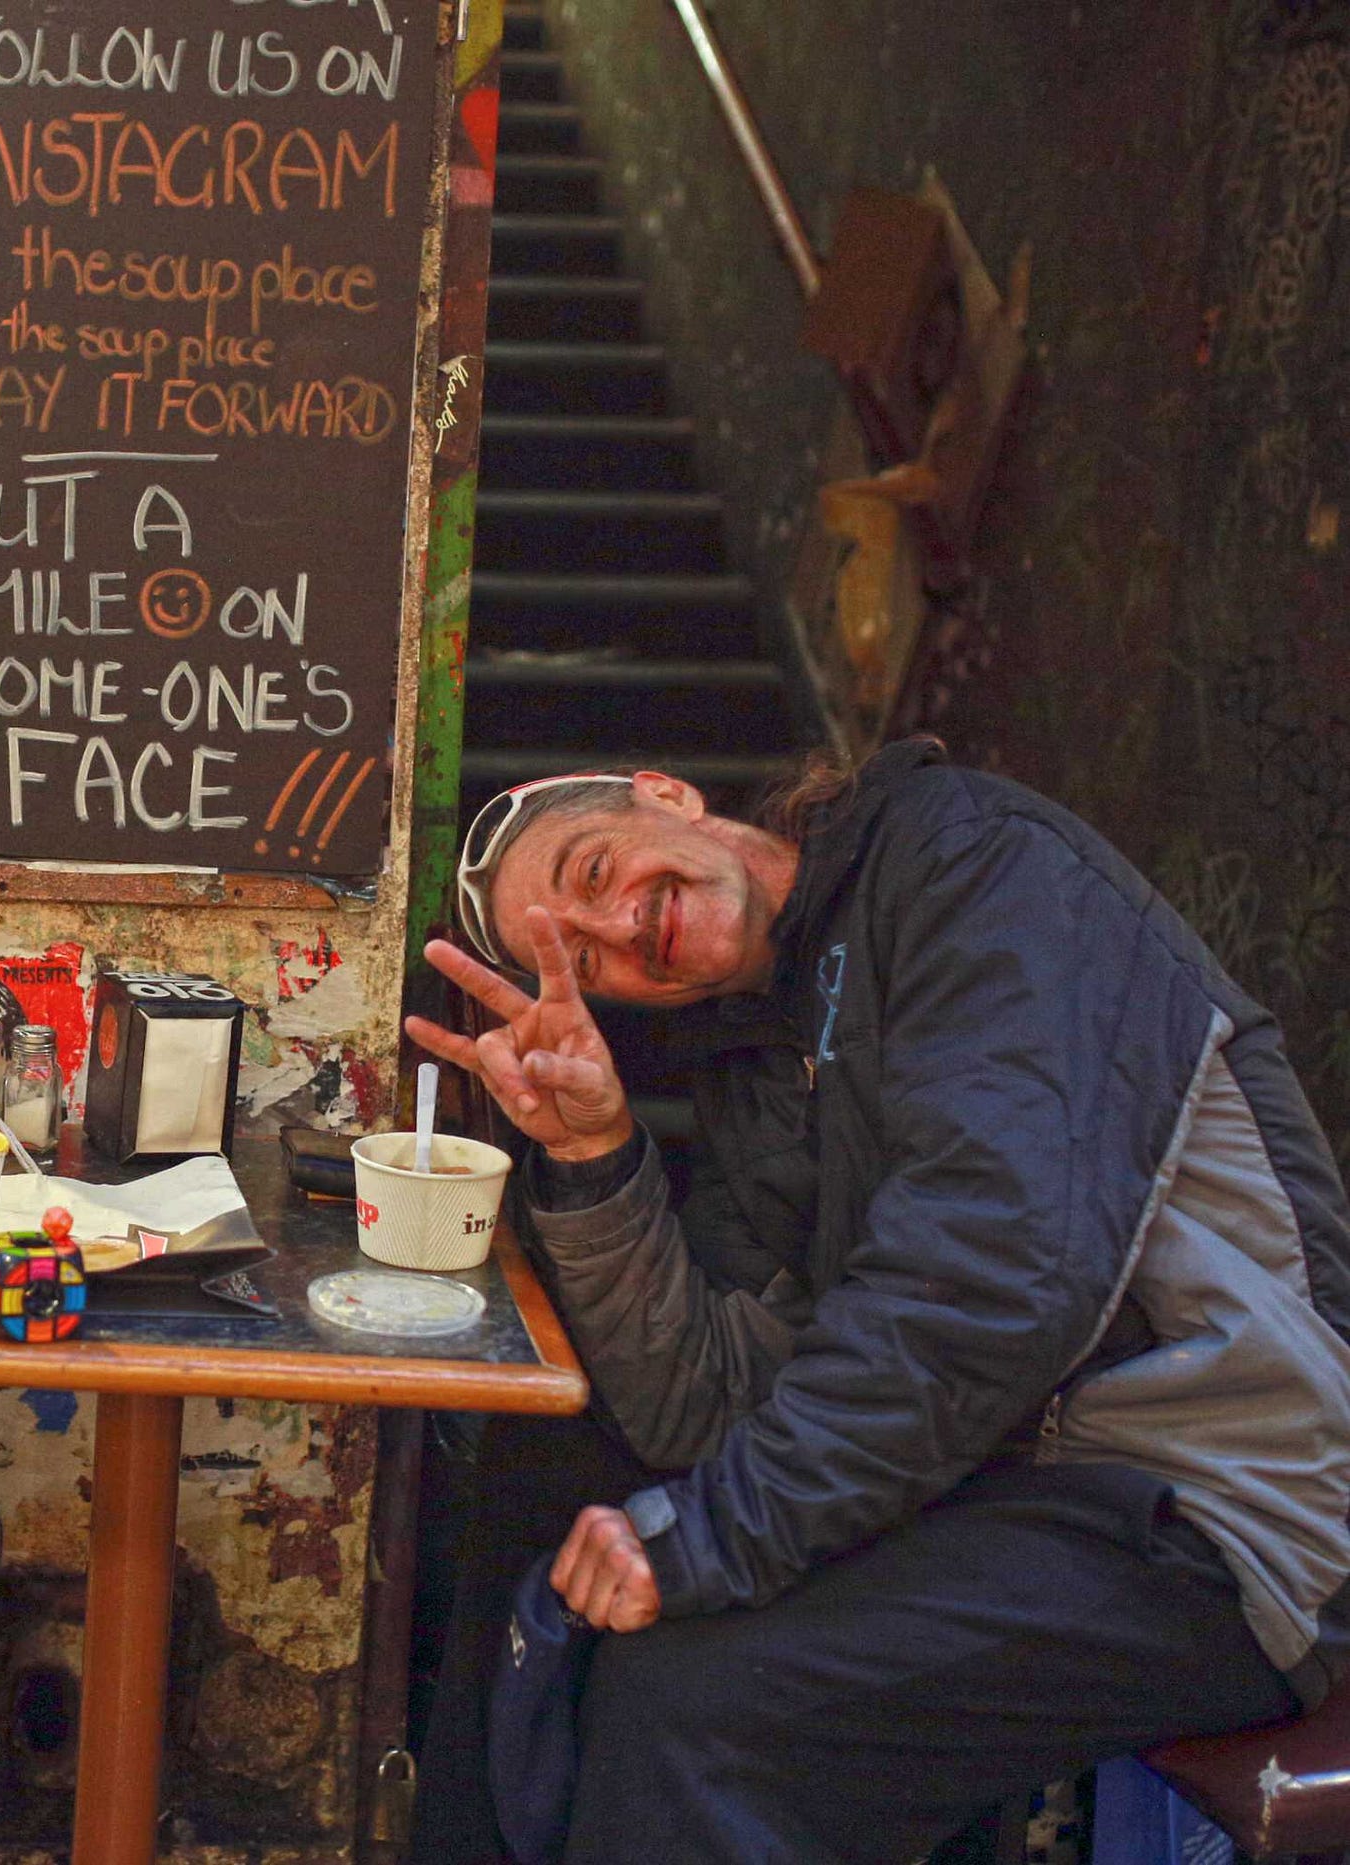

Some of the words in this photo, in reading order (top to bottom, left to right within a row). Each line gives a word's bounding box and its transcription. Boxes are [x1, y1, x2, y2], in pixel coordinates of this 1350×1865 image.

[208, 30, 301, 98] US
[317, 34, 403, 101] ON
[97, 372, 143, 437] IT
[157, 376, 398, 445] FORWARD
[134, 484, 192, 558] A
[219, 572, 308, 646] ON
[5, 727, 249, 833] FACE
[3, 966, 73, 985] PRESENTS
